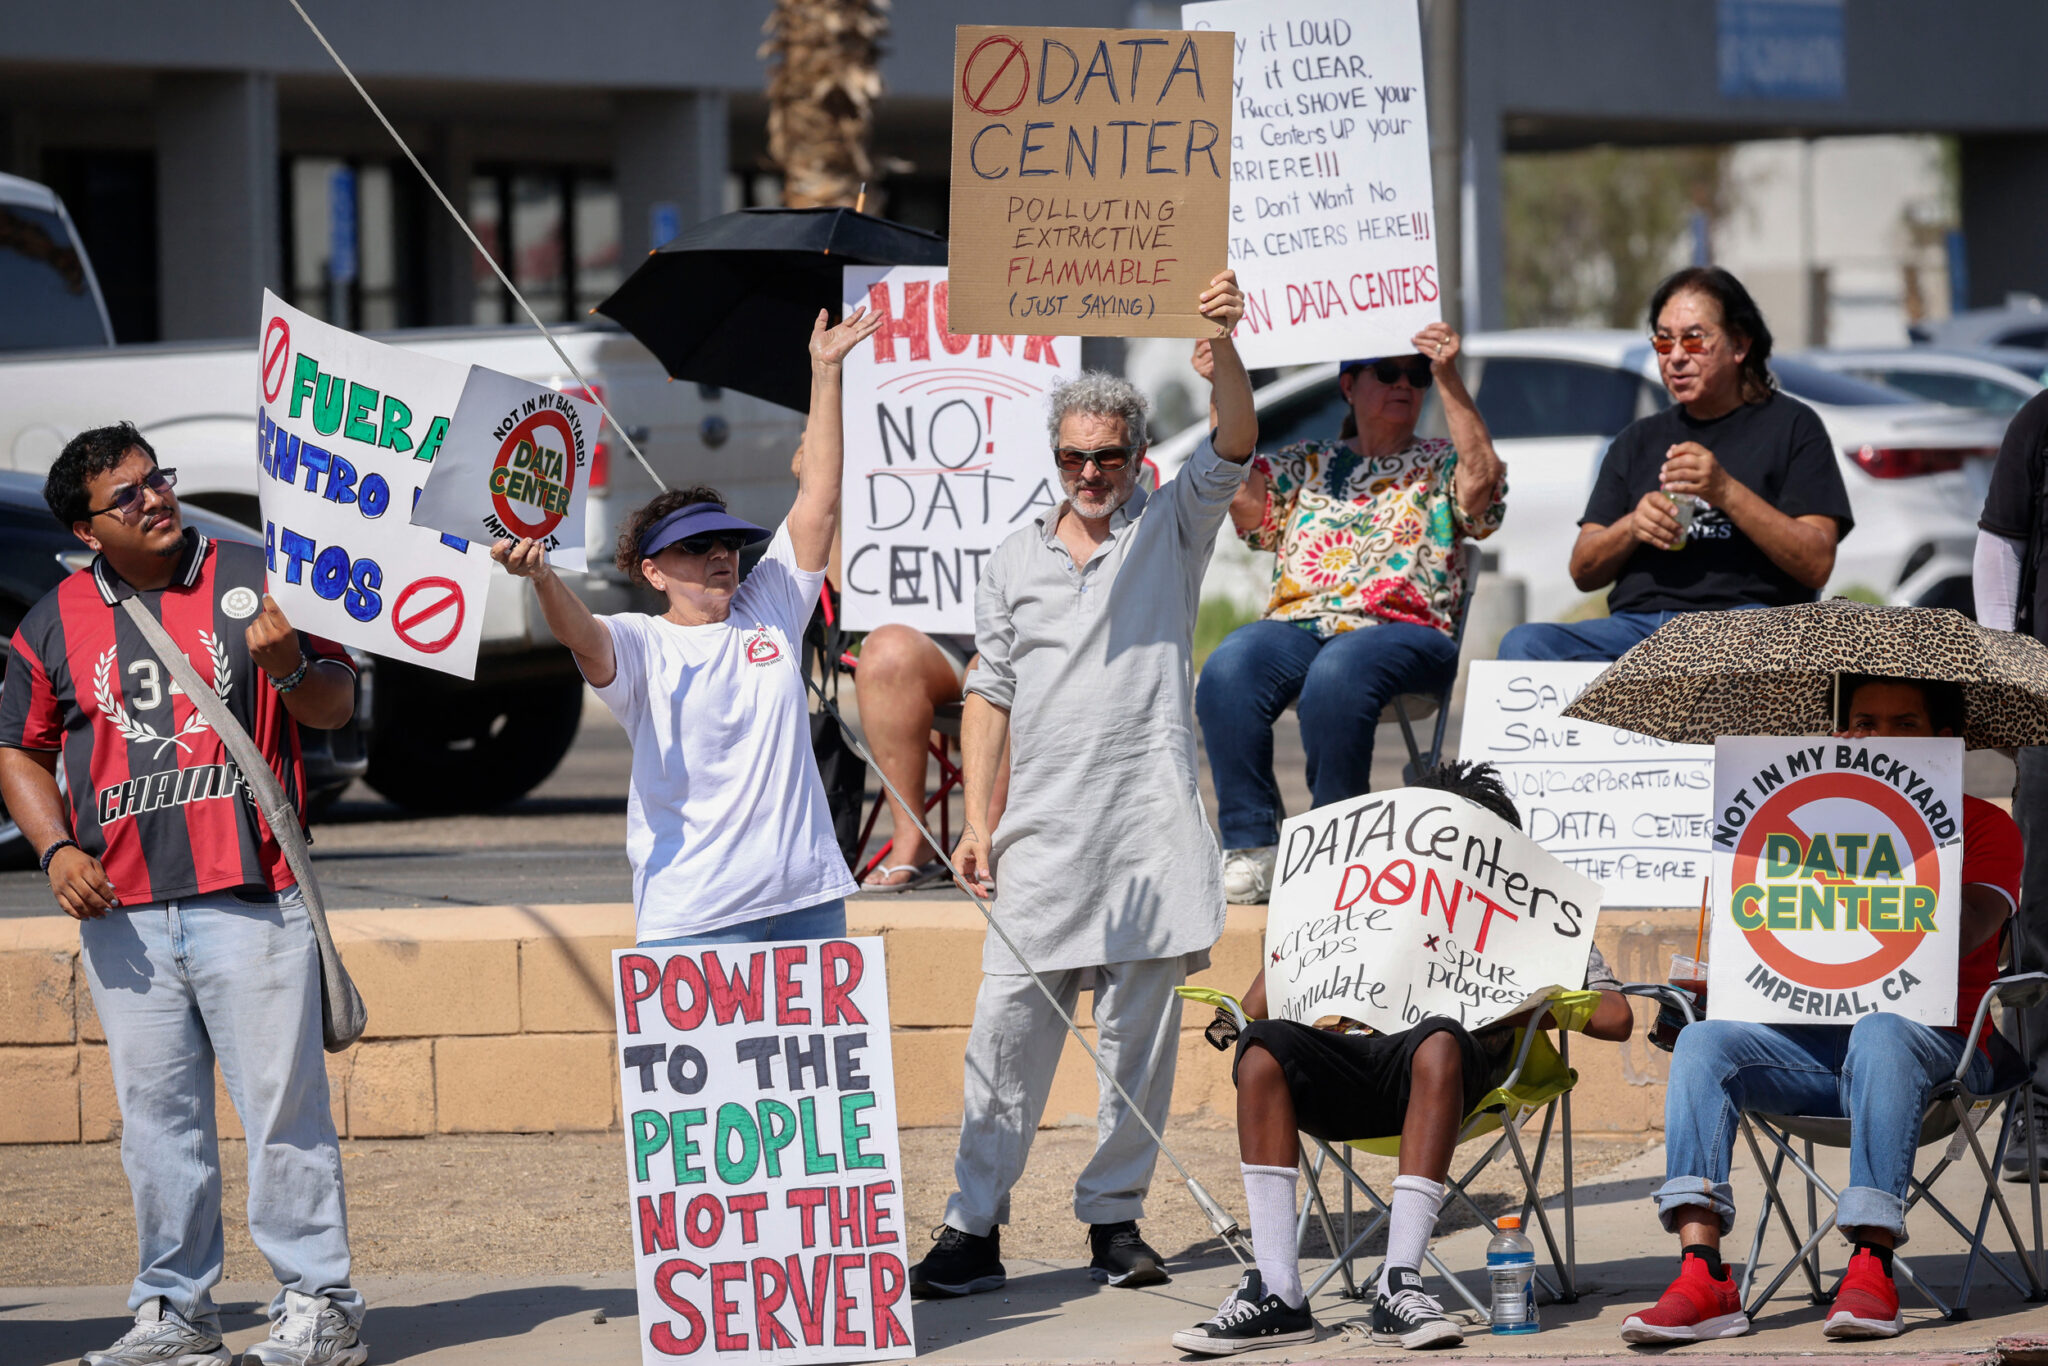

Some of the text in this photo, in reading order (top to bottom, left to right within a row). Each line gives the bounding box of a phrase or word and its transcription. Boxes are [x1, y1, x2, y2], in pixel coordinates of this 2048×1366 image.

[1260, 23, 1277, 52] it
[1287, 18, 1351, 48] LOUD
[1037, 34, 1205, 106] DATA
[1264, 59, 1283, 89] it
[1293, 55, 1372, 82] CLEAR.
[1297, 87, 1367, 115] SHOVE
[1374, 85, 1417, 113] your
[970, 119, 1222, 180] CENTER
[1260, 123, 1327, 148] Centers
[1330, 118, 1355, 139] UP
[1367, 118, 1412, 143] your
[1231, 151, 1339, 182] RRIERE!!!
[1008, 196, 1175, 222] POLLUTING
[1256, 190, 1299, 219] Don't
[1308, 182, 1354, 210] Want
[1370, 181, 1397, 204] No
[1012, 225, 1176, 251] EXTRACTIVE
[1264, 224, 1347, 256] CENTERS
[1358, 212, 1430, 241] HERE!!!
[1007, 256, 1178, 286] FLAMMABLE
[1286, 279, 1348, 326] DATA
[1350, 264, 1439, 312] CENTERS
[1009, 291, 1155, 319] (JUST SAYING)
[493, 393, 586, 467] NOT IN MY BACKYARD!
[877, 396, 994, 469] NO!
[257, 404, 390, 519] CENTRO
[513, 439, 564, 483] DATA
[489, 465, 571, 517] CENTER
[866, 470, 1057, 531] DATA
[265, 519, 383, 622] ATOS
[847, 543, 999, 611] CENT
[1488, 723, 1581, 752] SAVE
[1713, 744, 1962, 850] NOT IN MY BACKYARD!
[1280, 799, 1396, 887] DATA
[1530, 806, 1616, 844] DATA
[1563, 854, 1696, 882] THE PEOPLE
[1765, 832, 1904, 880] DATA
[1333, 858, 1519, 954] DON'T
[1730, 882, 1939, 932] CENTER
[618, 940, 868, 1034] POWER
[1744, 963, 1921, 1017] IMPERIAL, CA
[624, 1032, 870, 1095] TO THE
[631, 1091, 886, 1186] PEOPLE
[637, 1179, 900, 1256] NOT THE
[649, 1251, 911, 1357] SERVER
